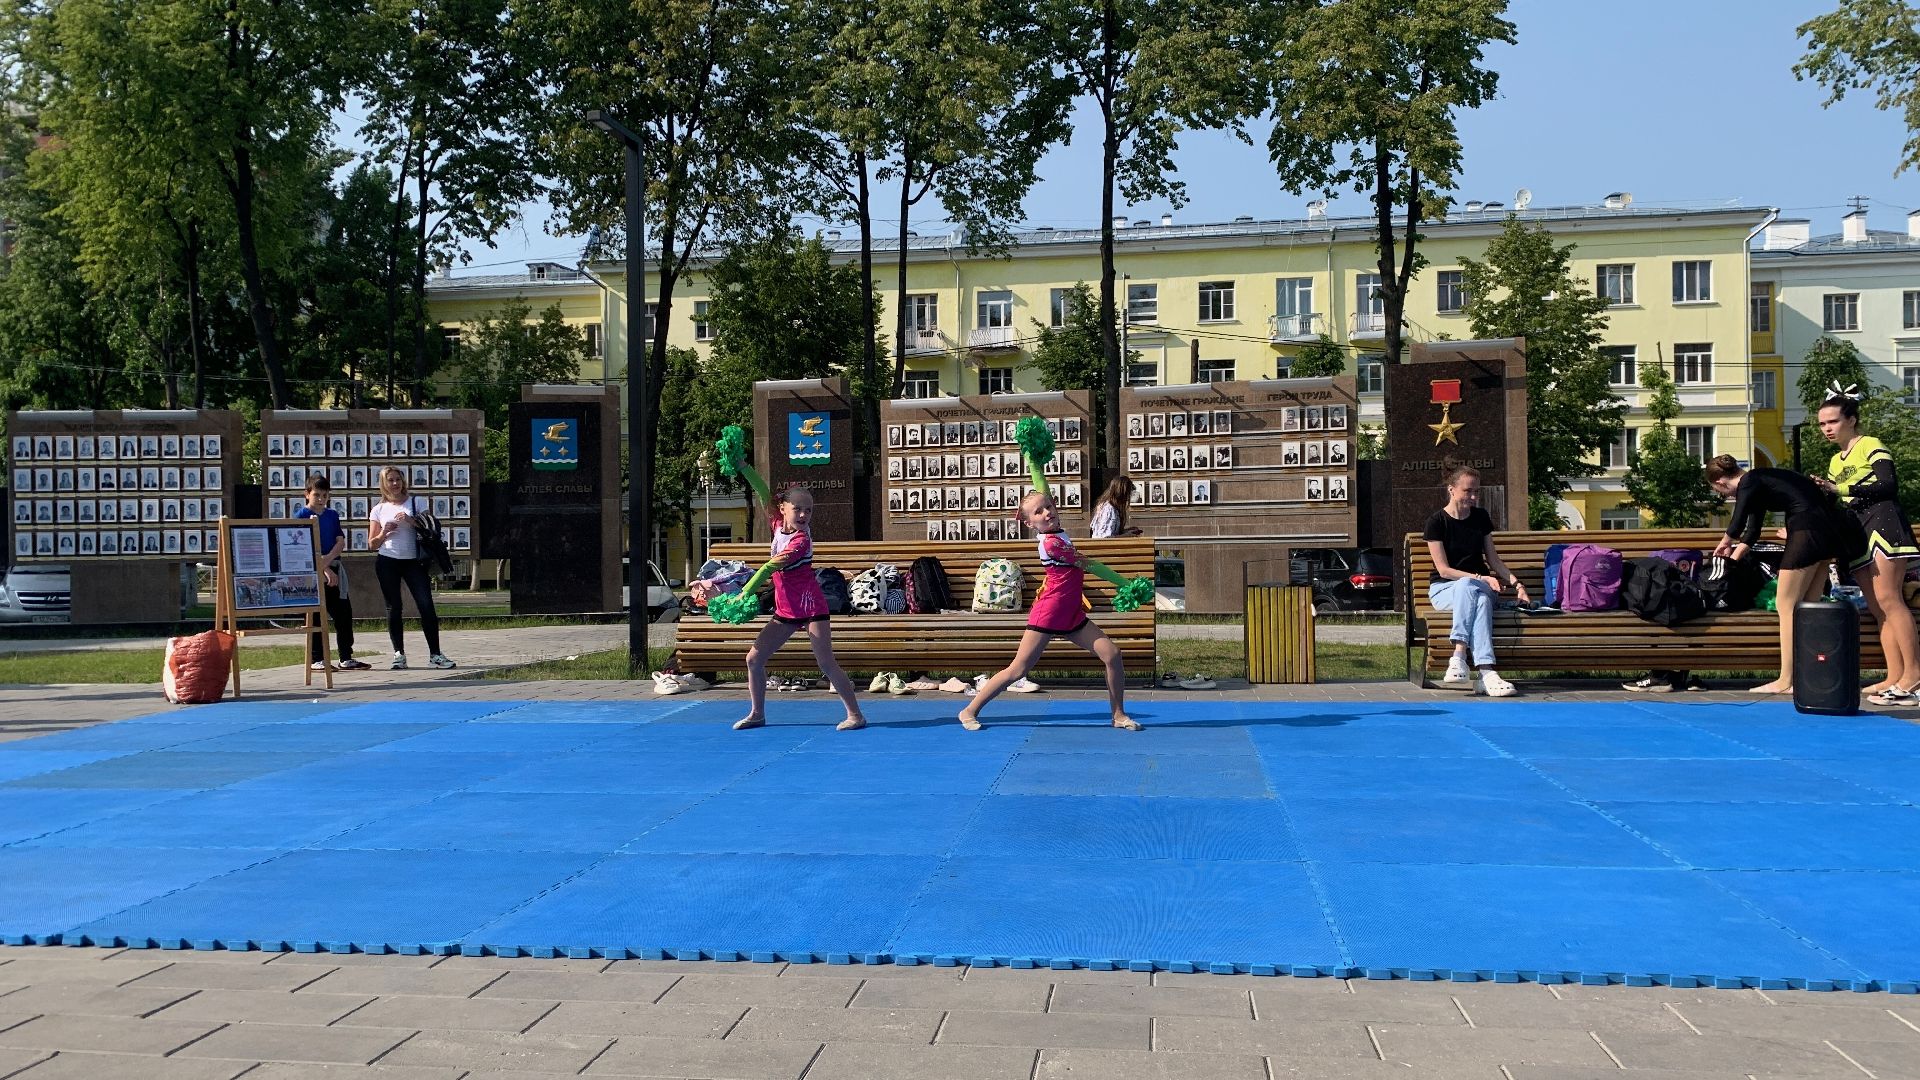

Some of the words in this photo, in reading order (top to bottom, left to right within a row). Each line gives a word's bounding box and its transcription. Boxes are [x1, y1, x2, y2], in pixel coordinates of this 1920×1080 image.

[1300, 390, 1333, 401] ТРУДА
[1401, 460, 1444, 471] АЛЛЕЯ
[517, 485, 553, 494] АЛЛЕЯ
[555, 484, 593, 493] СЛАВЫ
[811, 479, 847, 490] СЛАВЫ
